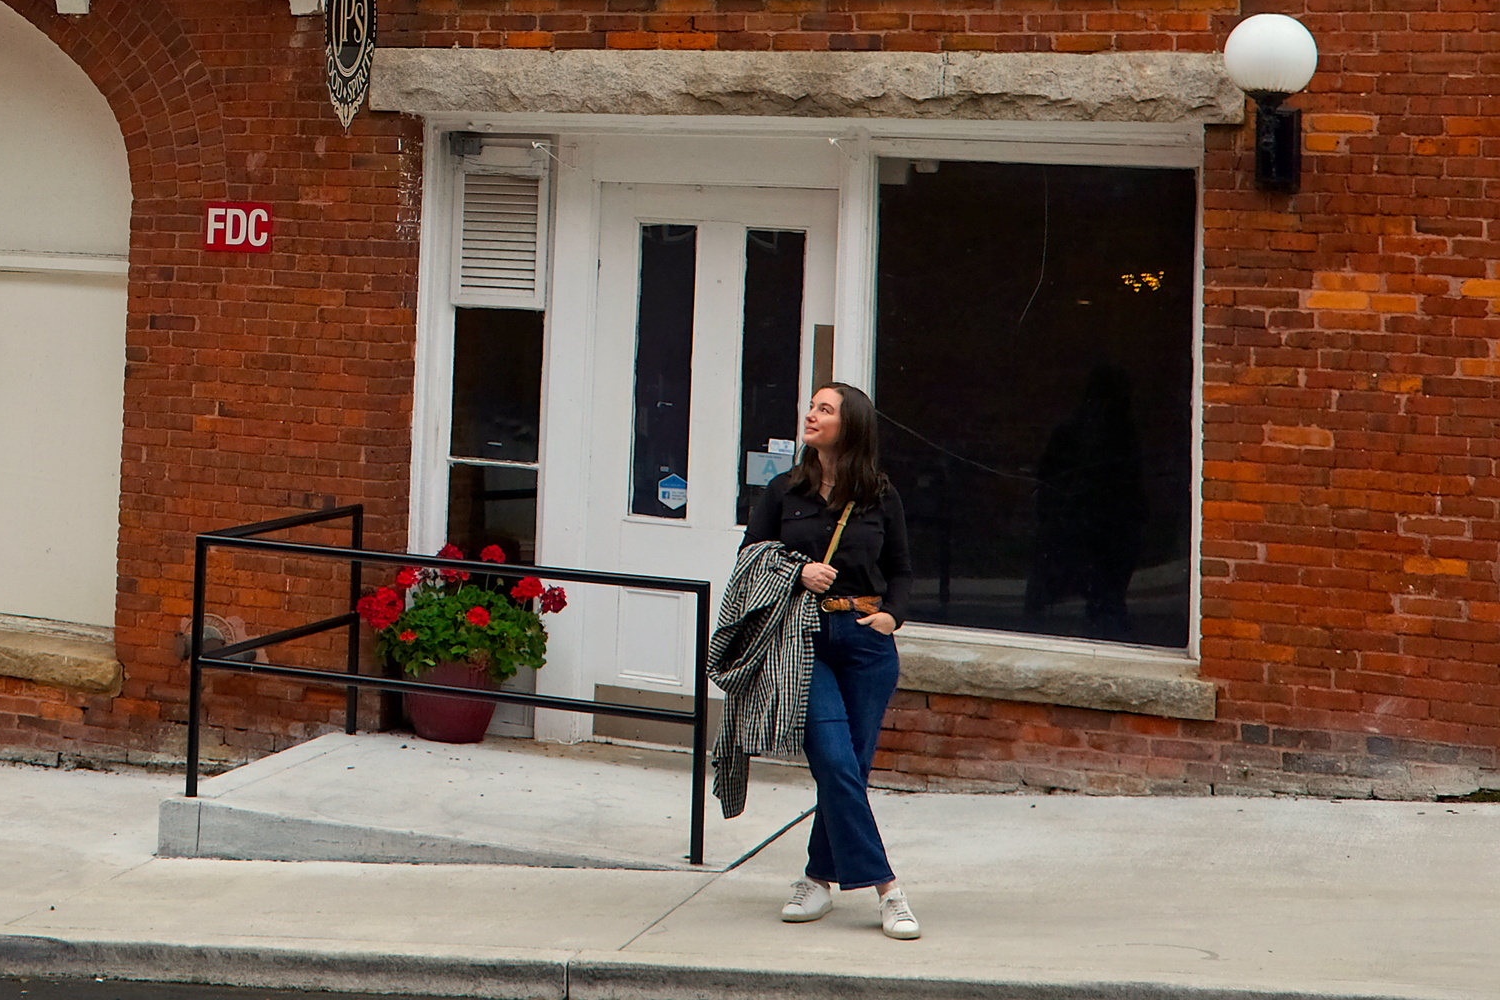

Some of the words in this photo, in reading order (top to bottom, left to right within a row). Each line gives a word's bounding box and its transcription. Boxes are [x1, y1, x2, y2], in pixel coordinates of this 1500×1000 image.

[326, 41, 343, 98] FOOD
[347, 38, 374, 102] SPIRITS
[206, 207, 269, 247] FDC
